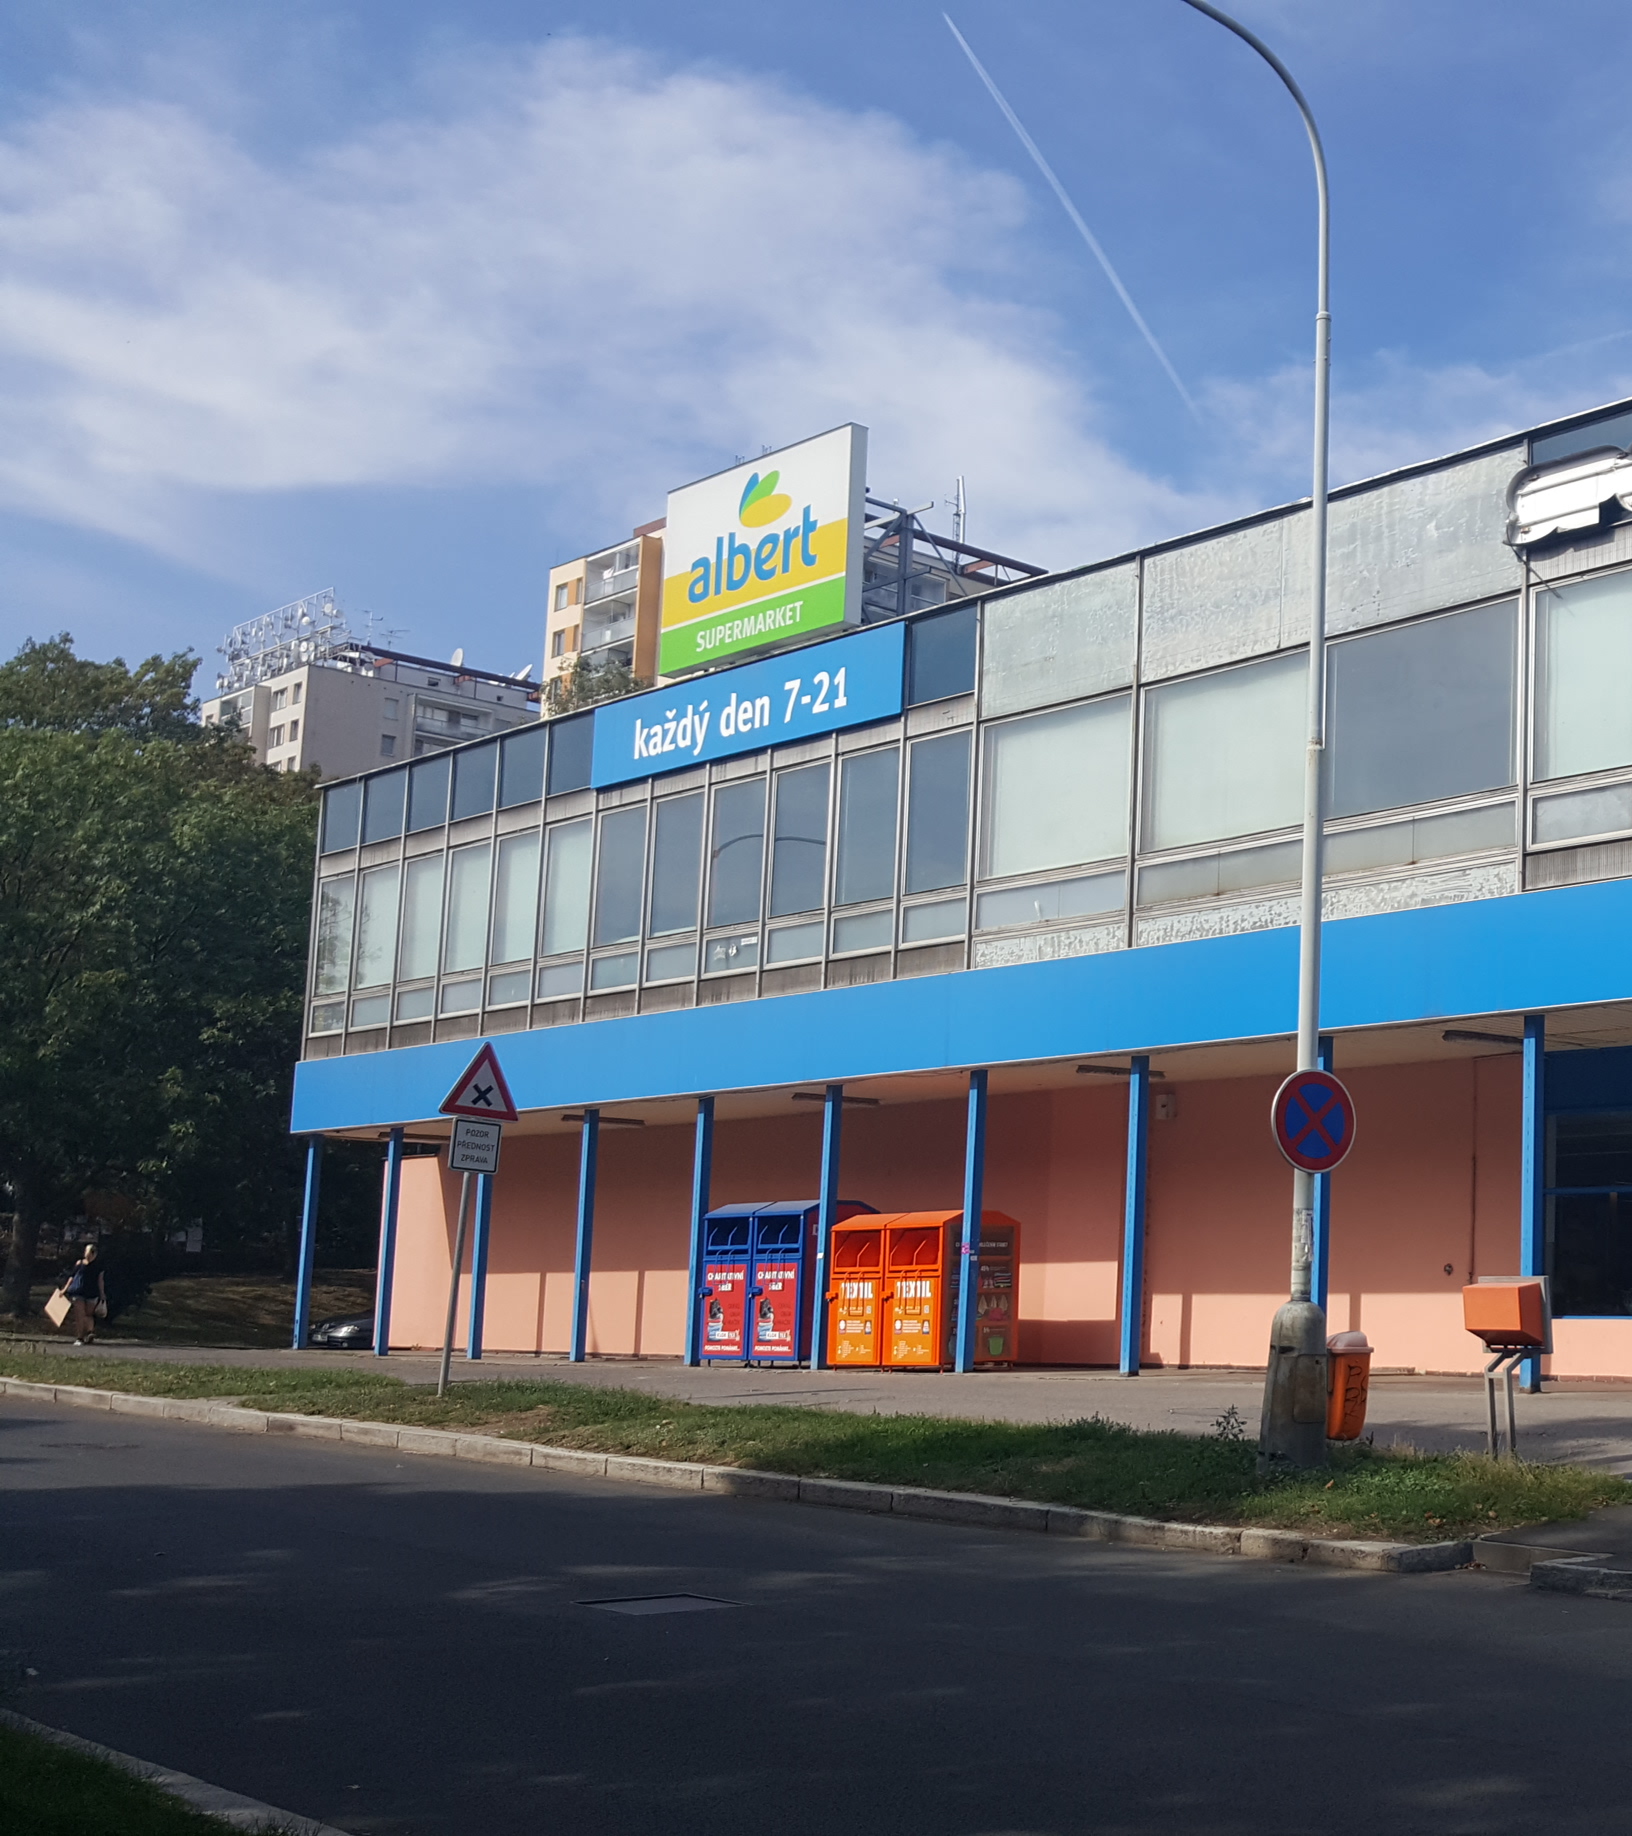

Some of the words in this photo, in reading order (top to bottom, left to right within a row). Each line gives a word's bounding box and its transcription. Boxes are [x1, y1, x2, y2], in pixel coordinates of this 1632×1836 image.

[688, 504, 819, 604] albert
[695, 601, 804, 653] SUPERMARKET
[633, 700, 710, 757] každý
[719, 693, 770, 738] den
[783, 667, 849, 725] 7-21
[457, 1140, 496, 1152] PŘEDNOST
[465, 1128, 490, 1138] POZOR
[460, 1153, 488, 1164] ZPRAVA
